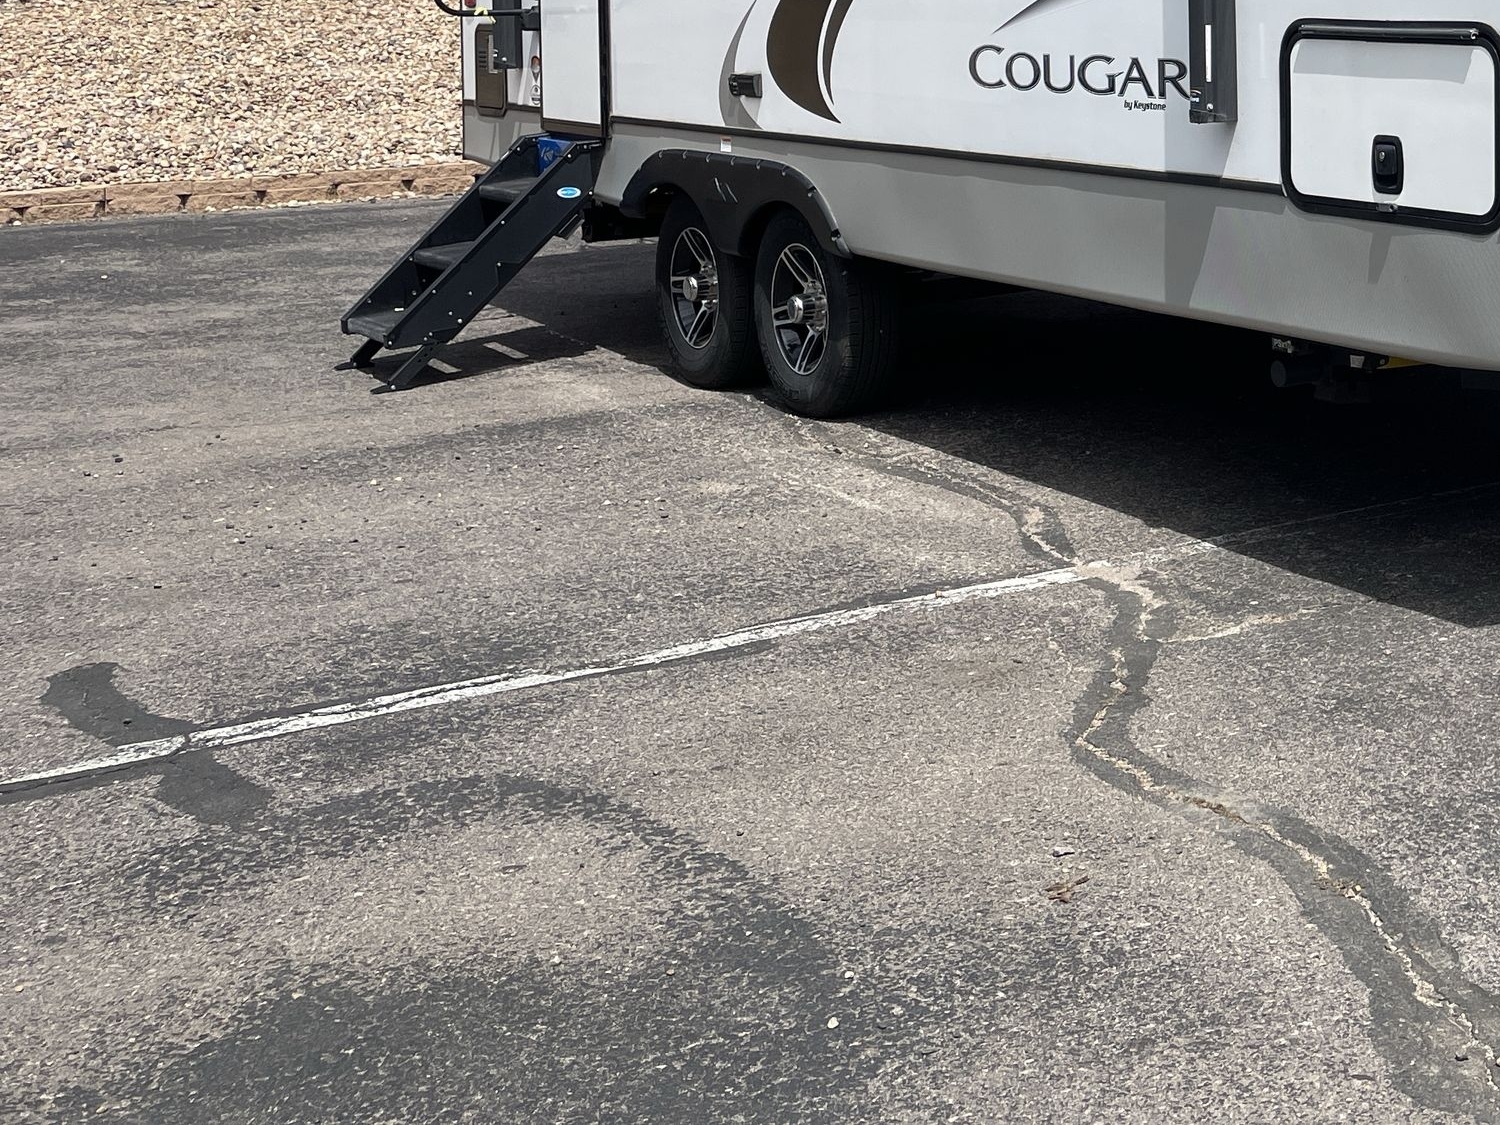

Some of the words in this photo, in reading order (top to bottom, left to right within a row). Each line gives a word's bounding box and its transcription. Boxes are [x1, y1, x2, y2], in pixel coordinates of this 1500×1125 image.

[968, 44, 1191, 101] COUGAR
[1123, 100, 1133, 111] by
[1133, 100, 1167, 111] Keystone
